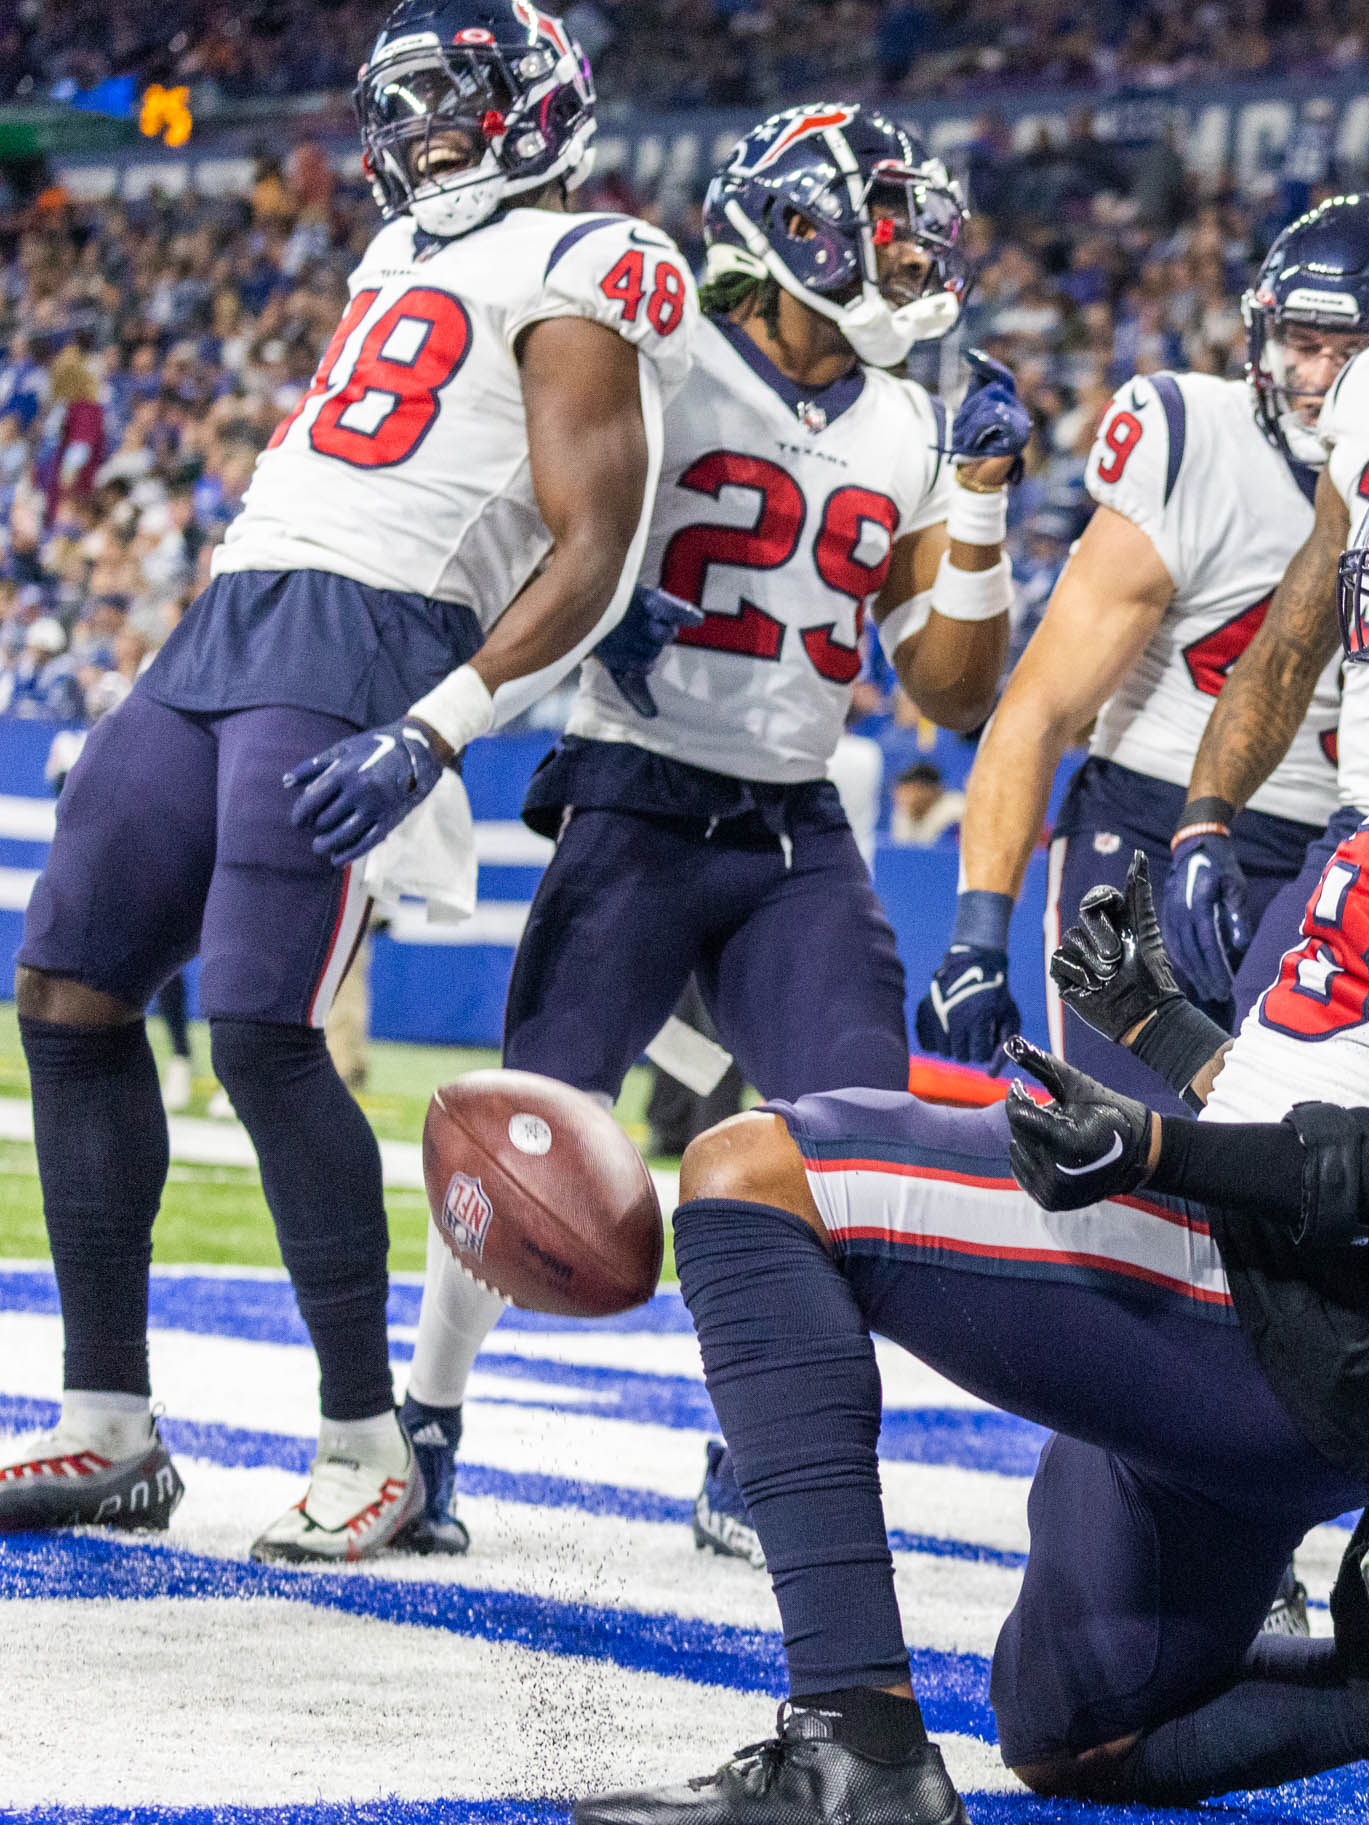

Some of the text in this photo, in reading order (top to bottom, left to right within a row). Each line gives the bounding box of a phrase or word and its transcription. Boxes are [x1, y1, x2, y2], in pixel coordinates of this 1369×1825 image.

[600, 248, 686, 337] 48
[775, 441, 848, 468] TEXANS
[660, 448, 901, 684] 29
[453, 1183, 486, 1232] NFL
